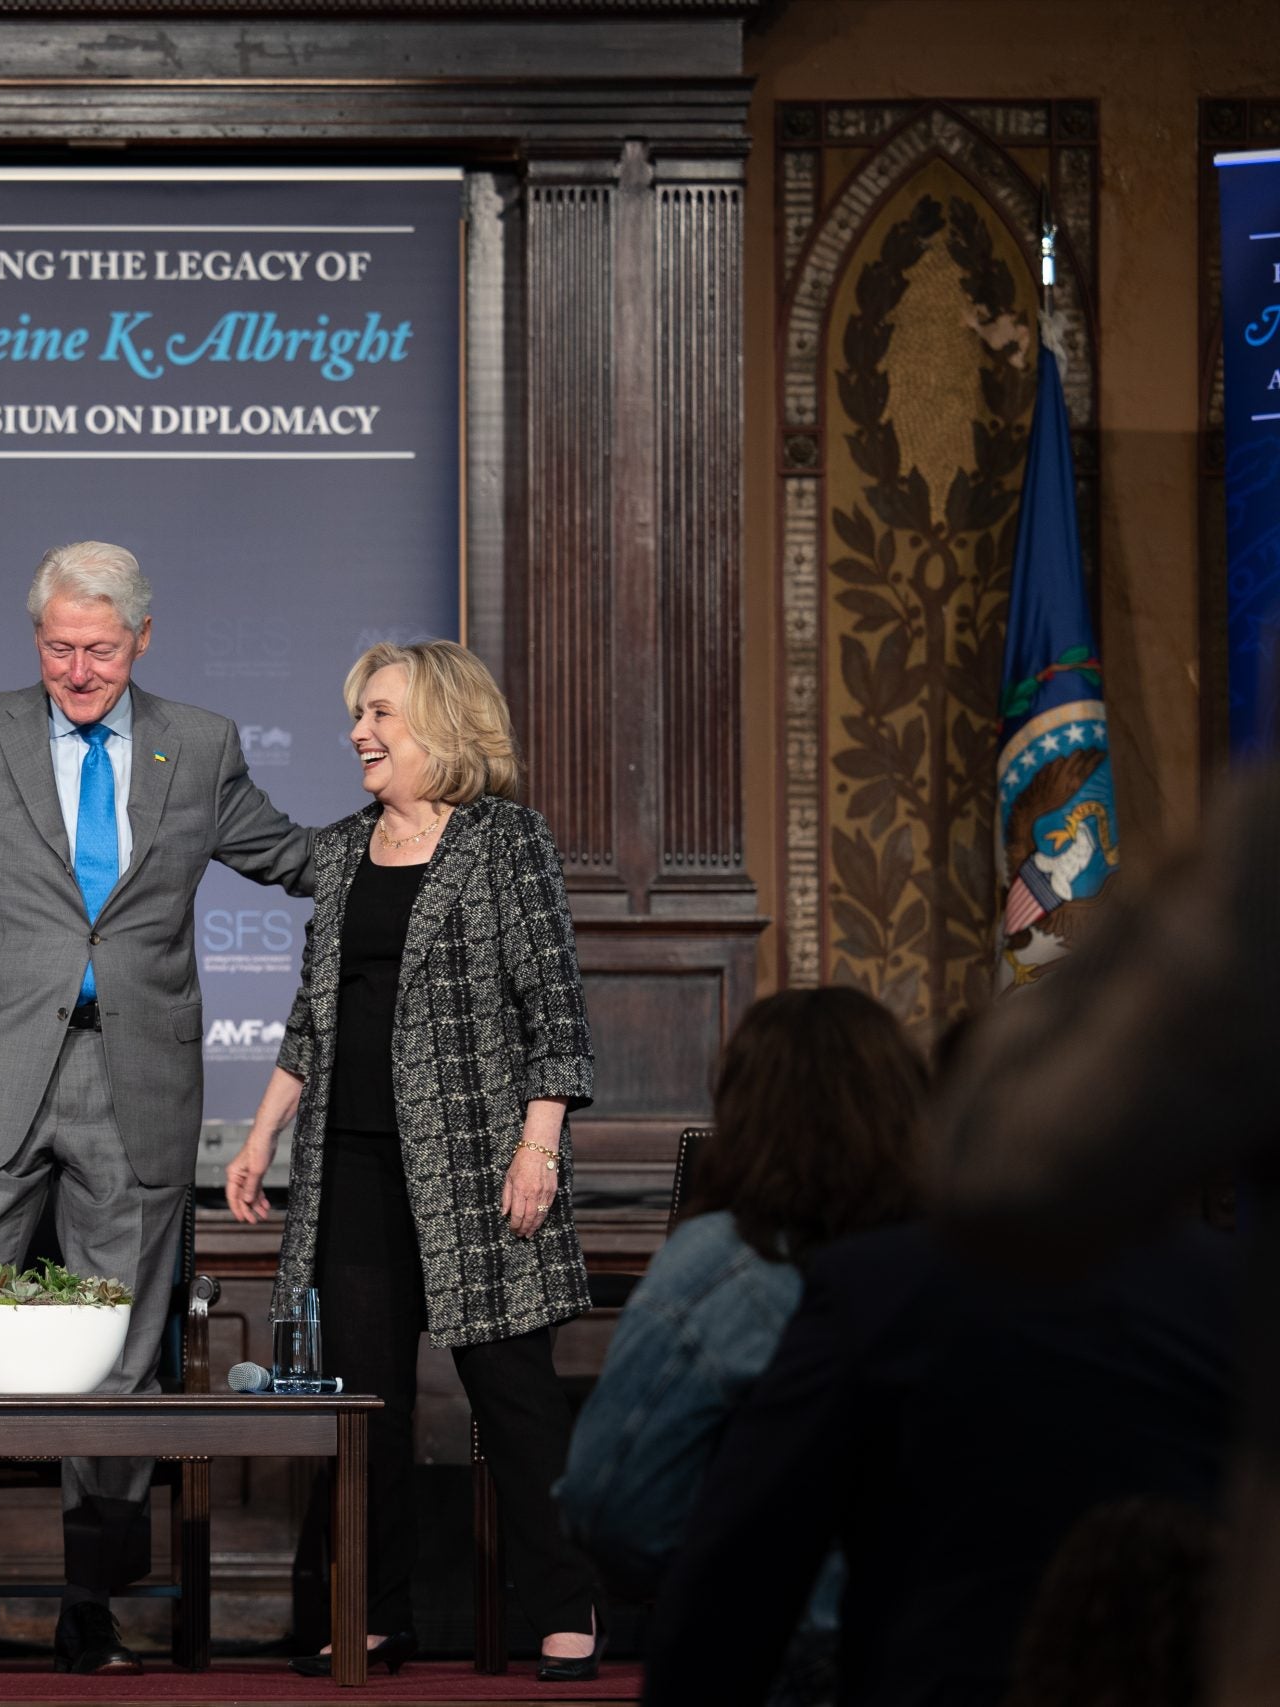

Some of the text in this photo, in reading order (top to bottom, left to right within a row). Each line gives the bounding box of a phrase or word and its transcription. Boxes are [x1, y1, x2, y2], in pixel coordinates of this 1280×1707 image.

[60, 250, 148, 281] THE
[154, 251, 311, 282] LEGACY
[315, 252, 372, 283] OF
[99, 311, 164, 380] K.
[166, 311, 413, 382] Albright
[84, 404, 145, 436] ON
[150, 404, 381, 436] DIPLOMACY
[202, 908, 294, 953] SFS
[205, 1019, 264, 1047] AMF
